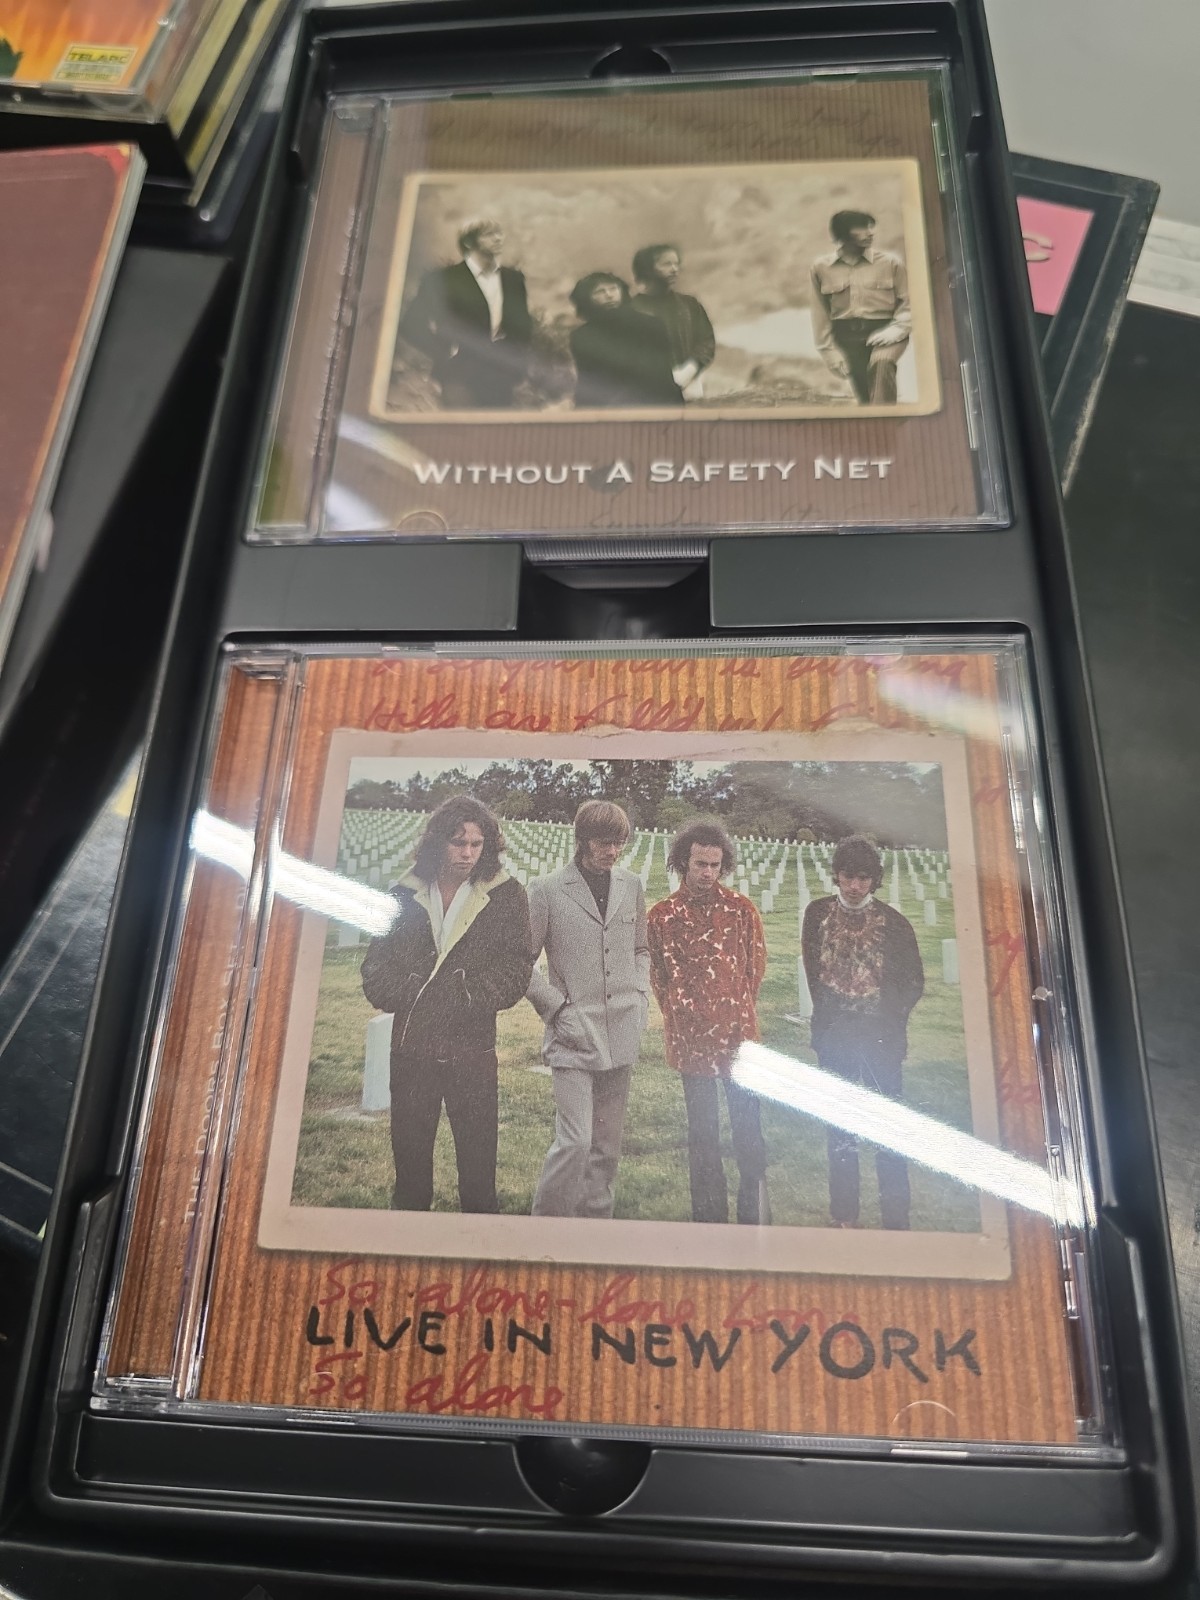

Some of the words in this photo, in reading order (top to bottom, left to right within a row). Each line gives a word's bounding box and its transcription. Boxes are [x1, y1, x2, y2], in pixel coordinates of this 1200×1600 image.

[412, 460, 593, 484] WITHOUT
[606, 459, 633, 483] A
[650, 460, 797, 482] SAFETY
[814, 455, 893, 480] NET
[318, 1257, 379, 1306] So
[306, 1306, 448, 1355] LIVE
[485, 1317, 552, 1356] IN
[592, 1321, 742, 1373] NEW
[768, 1318, 983, 1384] YORK
[309, 1351, 369, 1401] So
